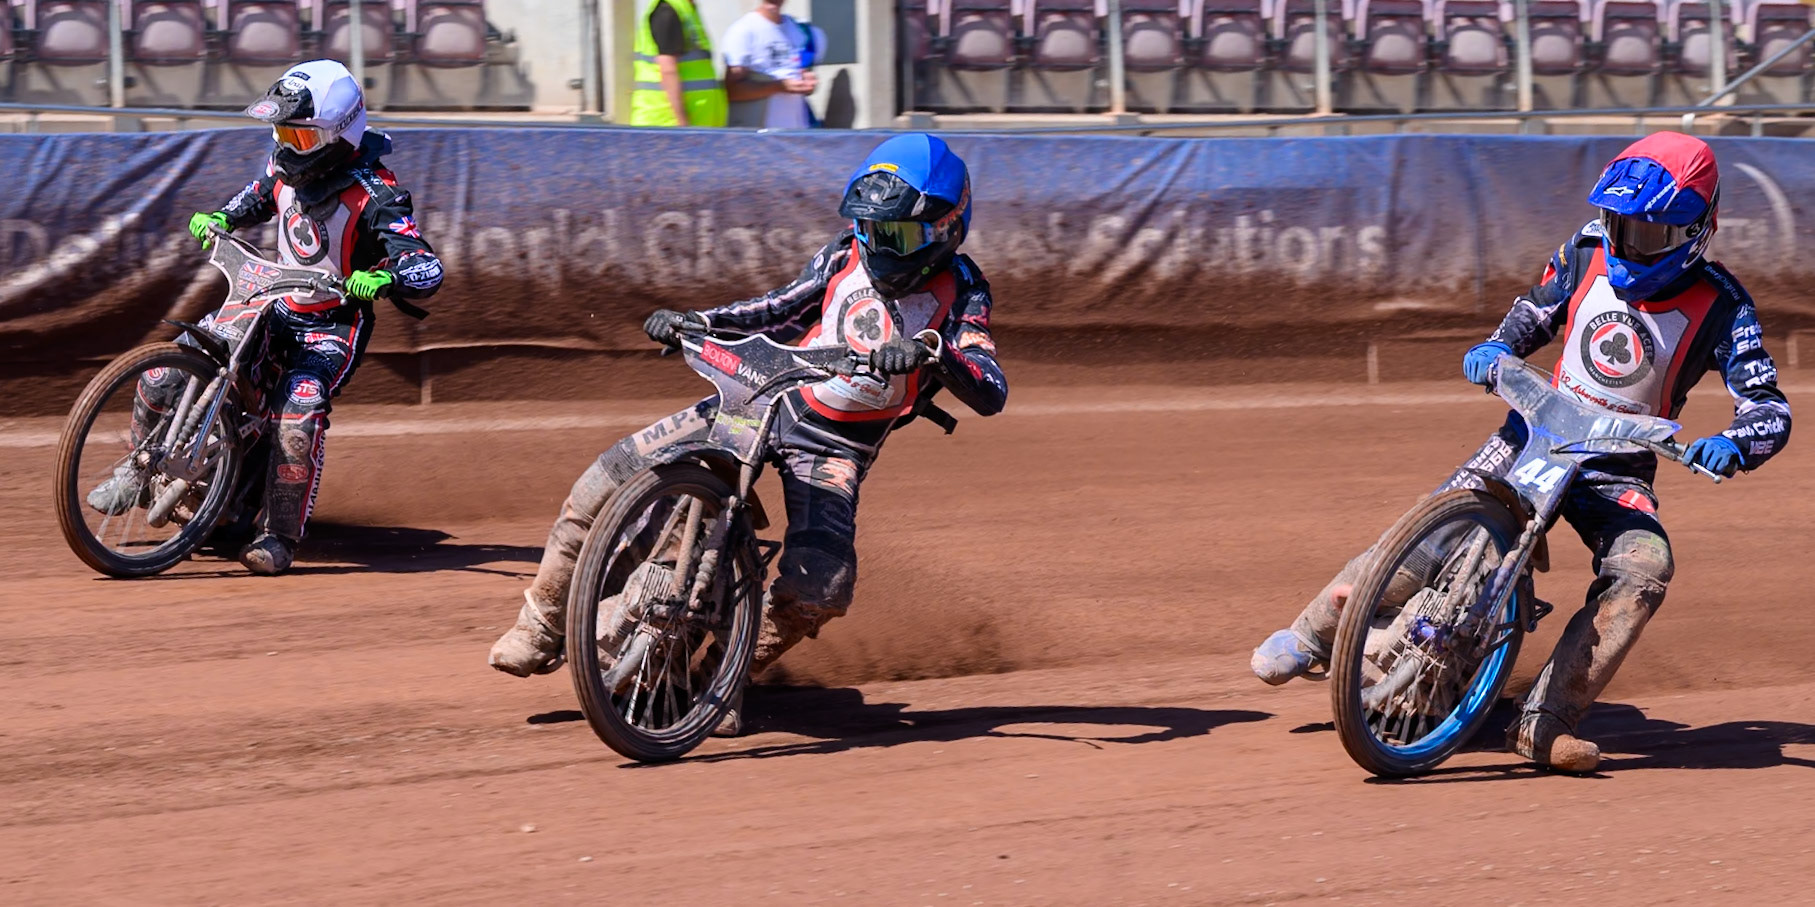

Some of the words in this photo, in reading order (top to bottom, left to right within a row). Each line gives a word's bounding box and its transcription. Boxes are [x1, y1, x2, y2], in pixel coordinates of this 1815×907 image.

[846, 287, 876, 305] BELLE
[1589, 312, 1618, 331] BELLE
[1622, 314, 1641, 331] VUE
[1640, 332, 1654, 359] ACES
[703, 344, 738, 371] BOLTON
[737, 363, 768, 386] VANS
[1588, 366, 1624, 386] MANCHESTER
[293, 383, 319, 395] STS
[642, 410, 702, 445] M.P.
[1722, 425, 1754, 439] Paul
[1514, 457, 1569, 494] 44
